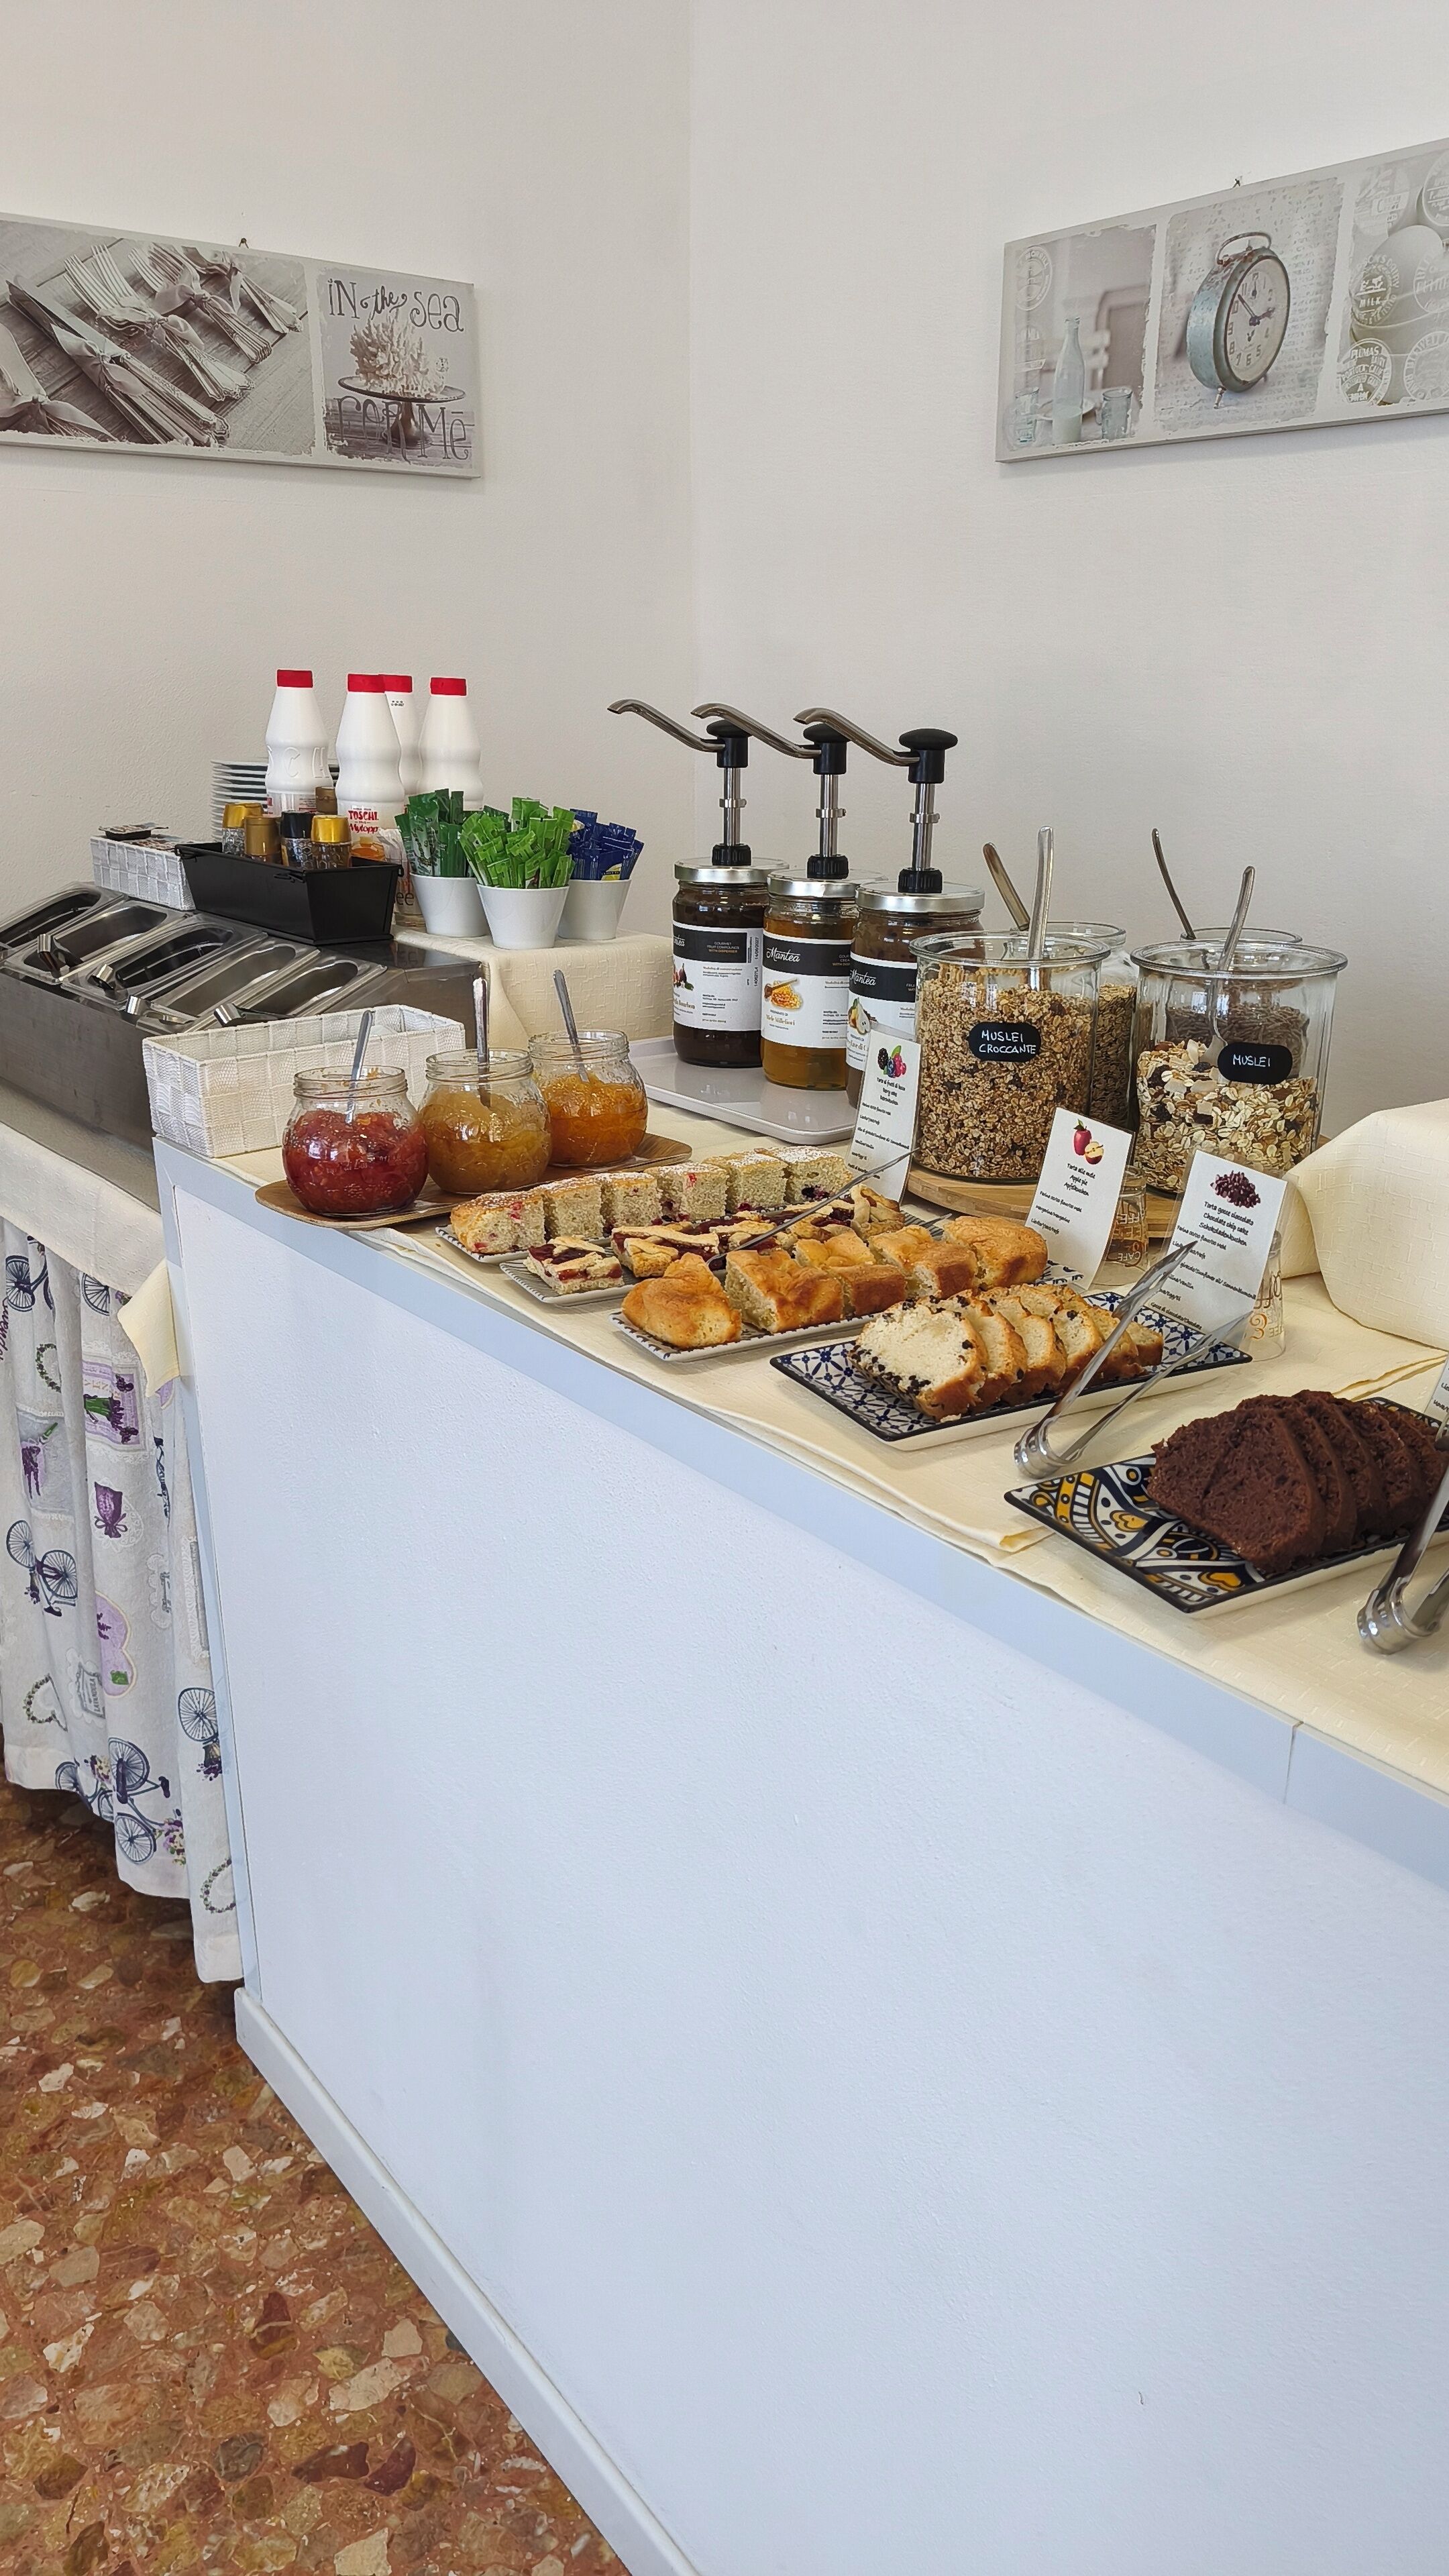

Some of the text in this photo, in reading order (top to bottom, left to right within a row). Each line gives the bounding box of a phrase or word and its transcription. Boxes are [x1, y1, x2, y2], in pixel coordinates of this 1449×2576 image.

[361, 285, 408, 321] the
[410, 291, 464, 332] sea
[348, 810, 378, 820] TOSCHI
[766, 947, 801, 963] Mantea
[850, 969, 877, 986] Mantea
[981, 1030, 1023, 1042] MUSLEI
[979, 1044, 1036, 1054] CROCCANTE
[1232, 1054, 1271, 1067] MUSLEI
[1067, 1163, 1077, 1172] Torta
[1070, 1175, 1081, 1183] Apple
[1205, 1201, 1254, 1226] Torta gocce cioccolato
[1203, 1213, 1248, 1235] Chocolate chip cake
[1199, 1222, 1247, 1246] Schokoladenkuchen
